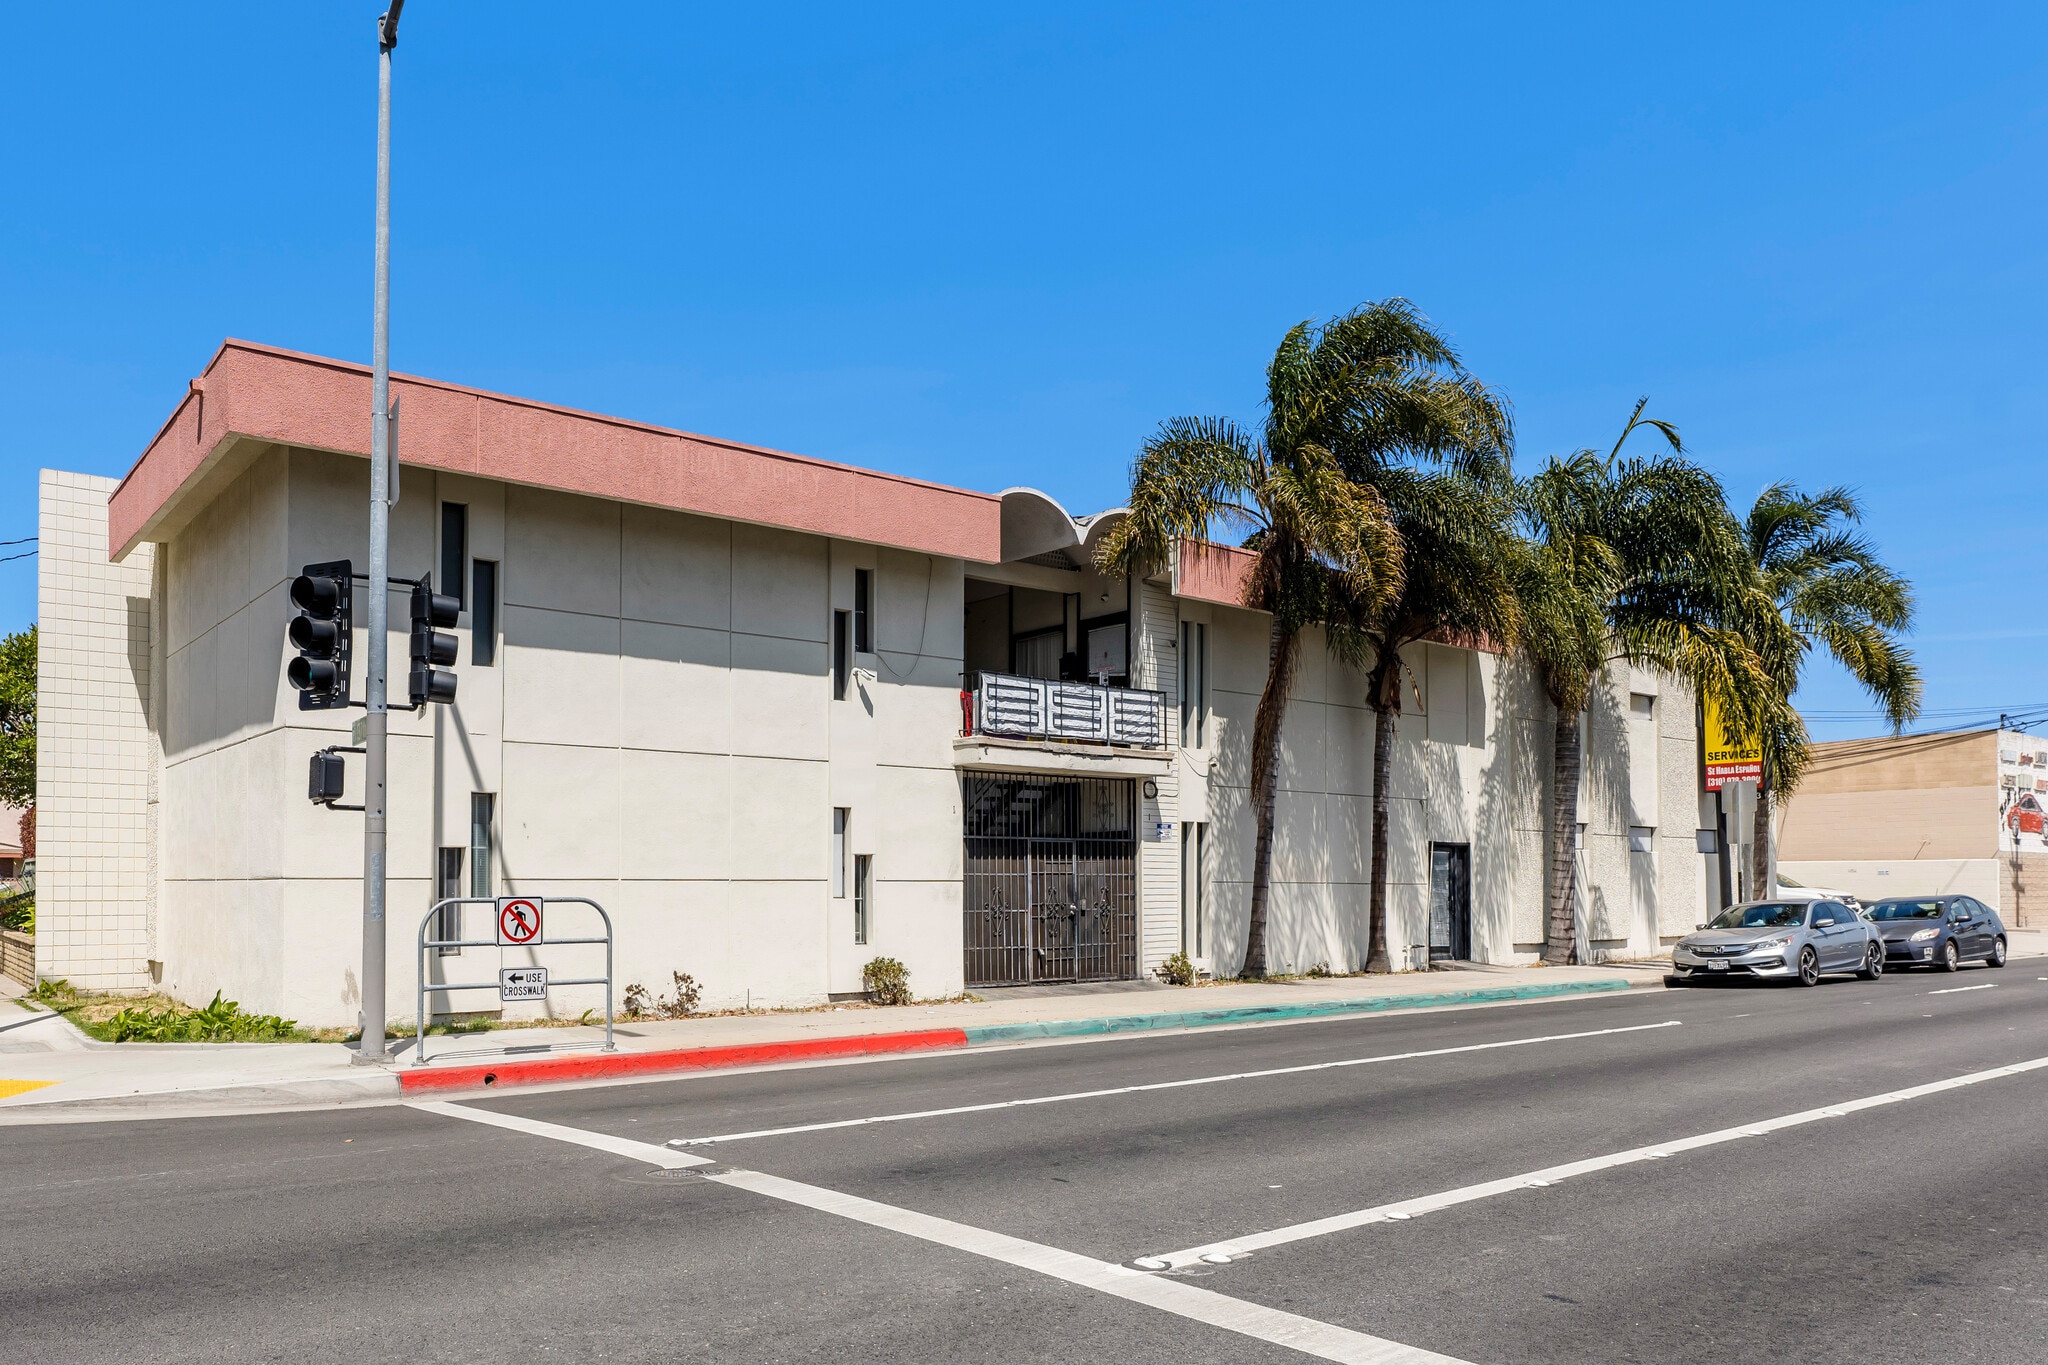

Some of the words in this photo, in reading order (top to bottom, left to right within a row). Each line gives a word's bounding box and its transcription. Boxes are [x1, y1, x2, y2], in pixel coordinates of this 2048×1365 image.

[1707, 749, 1760, 761] SERVICES
[526, 973, 542, 983] USE
[504, 985, 545, 996] CROSSWALK
